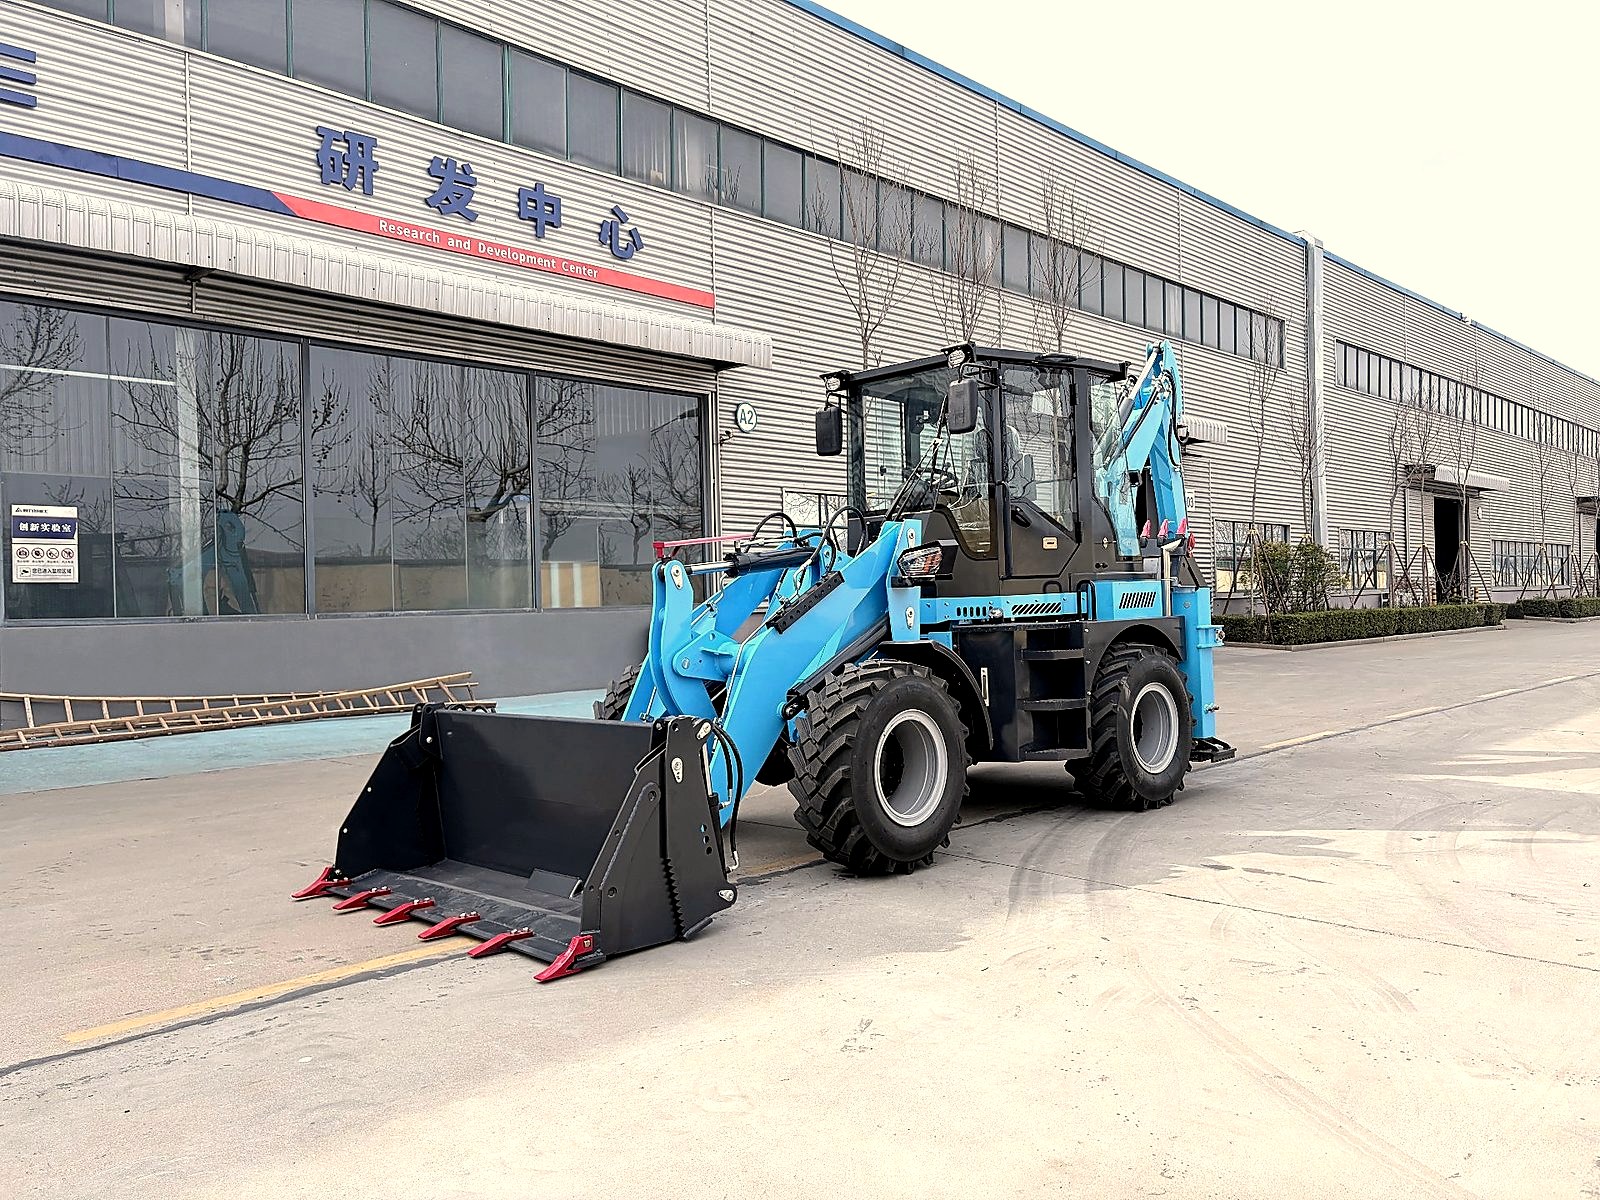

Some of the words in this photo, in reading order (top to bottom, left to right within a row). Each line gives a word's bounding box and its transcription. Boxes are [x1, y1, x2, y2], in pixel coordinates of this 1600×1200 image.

[315, 125, 644, 260] 研发中心
[379, 219, 440, 244] Research
[447, 236, 471, 251] and
[478, 242, 556, 269] Development
[562, 261, 599, 279] Center
[740, 409, 753, 425] A2
[19, 522, 71, 532] 创新实验室
